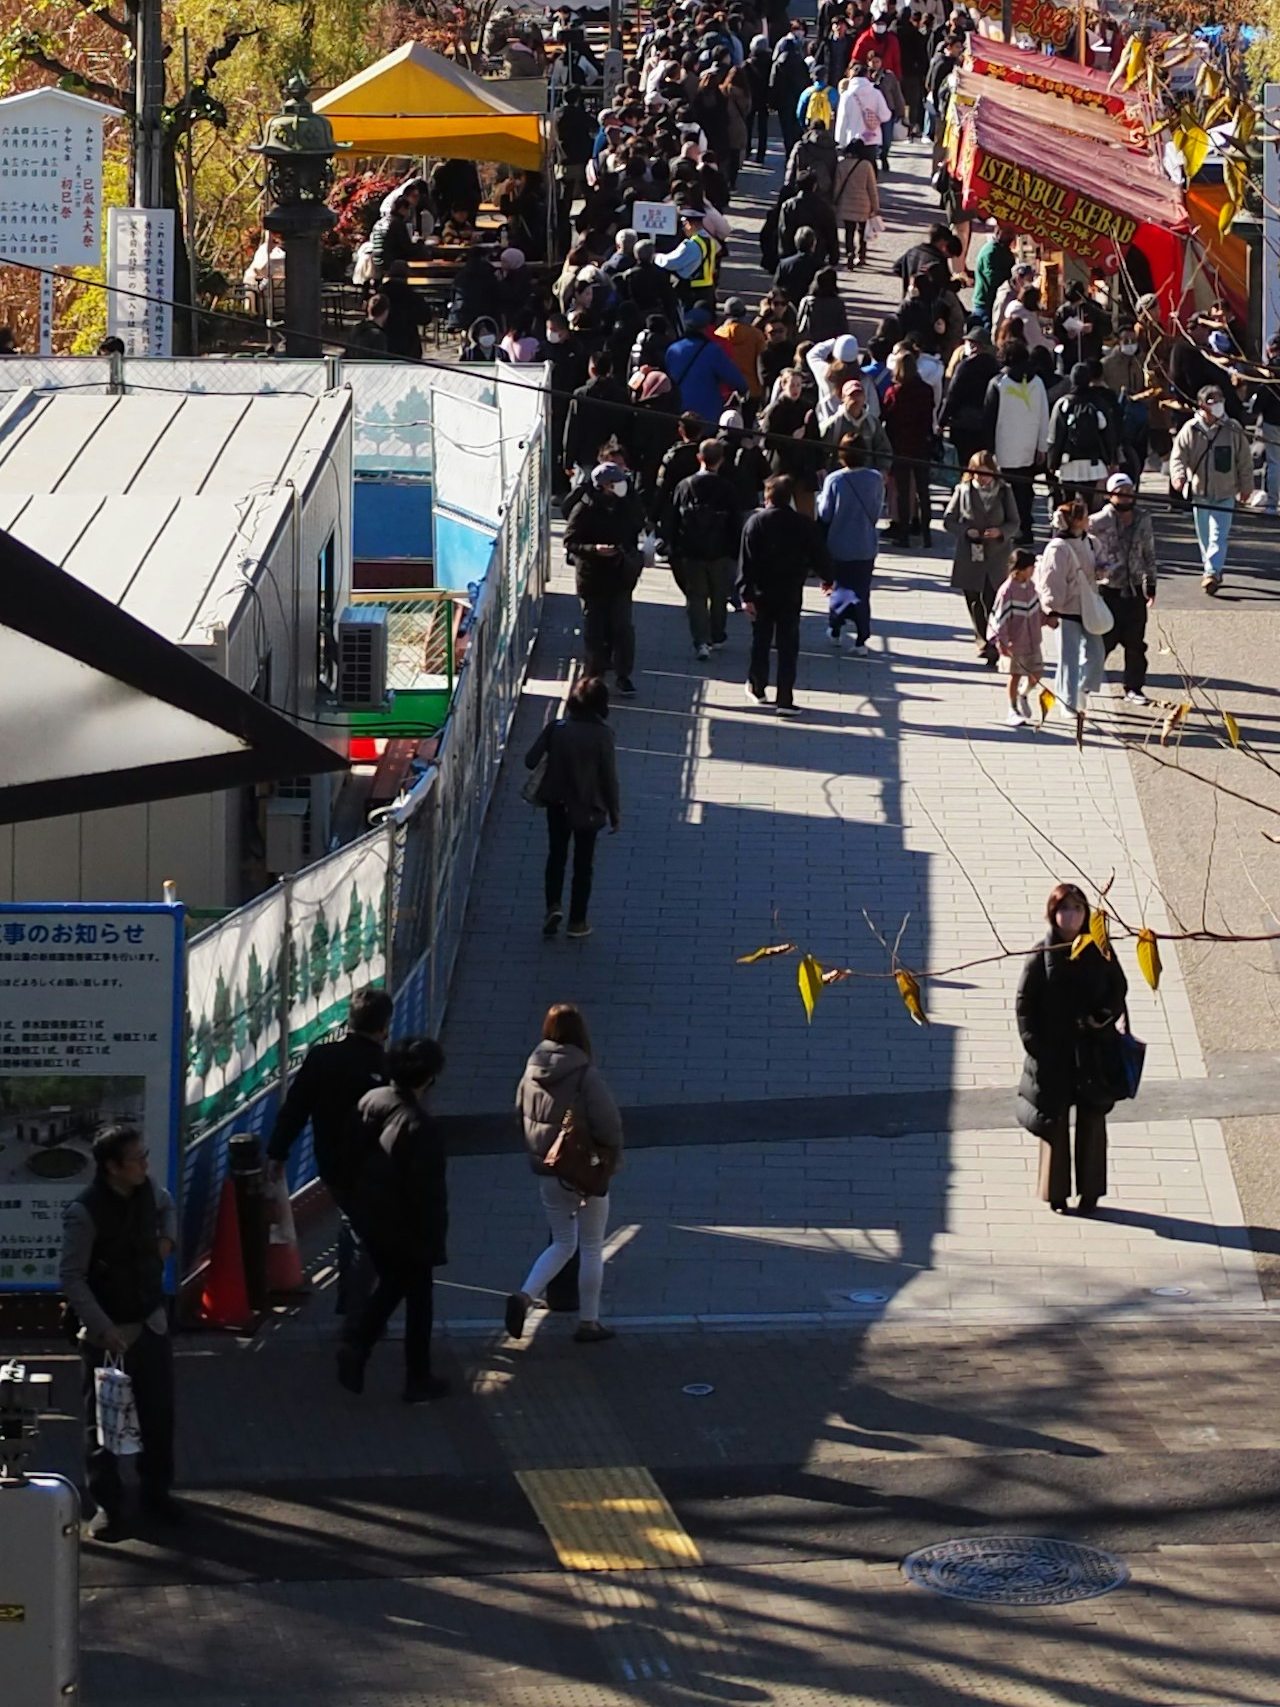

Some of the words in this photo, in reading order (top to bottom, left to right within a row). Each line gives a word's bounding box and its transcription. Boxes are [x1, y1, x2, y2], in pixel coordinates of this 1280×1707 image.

[85, 126, 94, 163] 令和七年
[976, 154, 1067, 215] ISTANBUL
[1070, 196, 1137, 245] KEBAB
